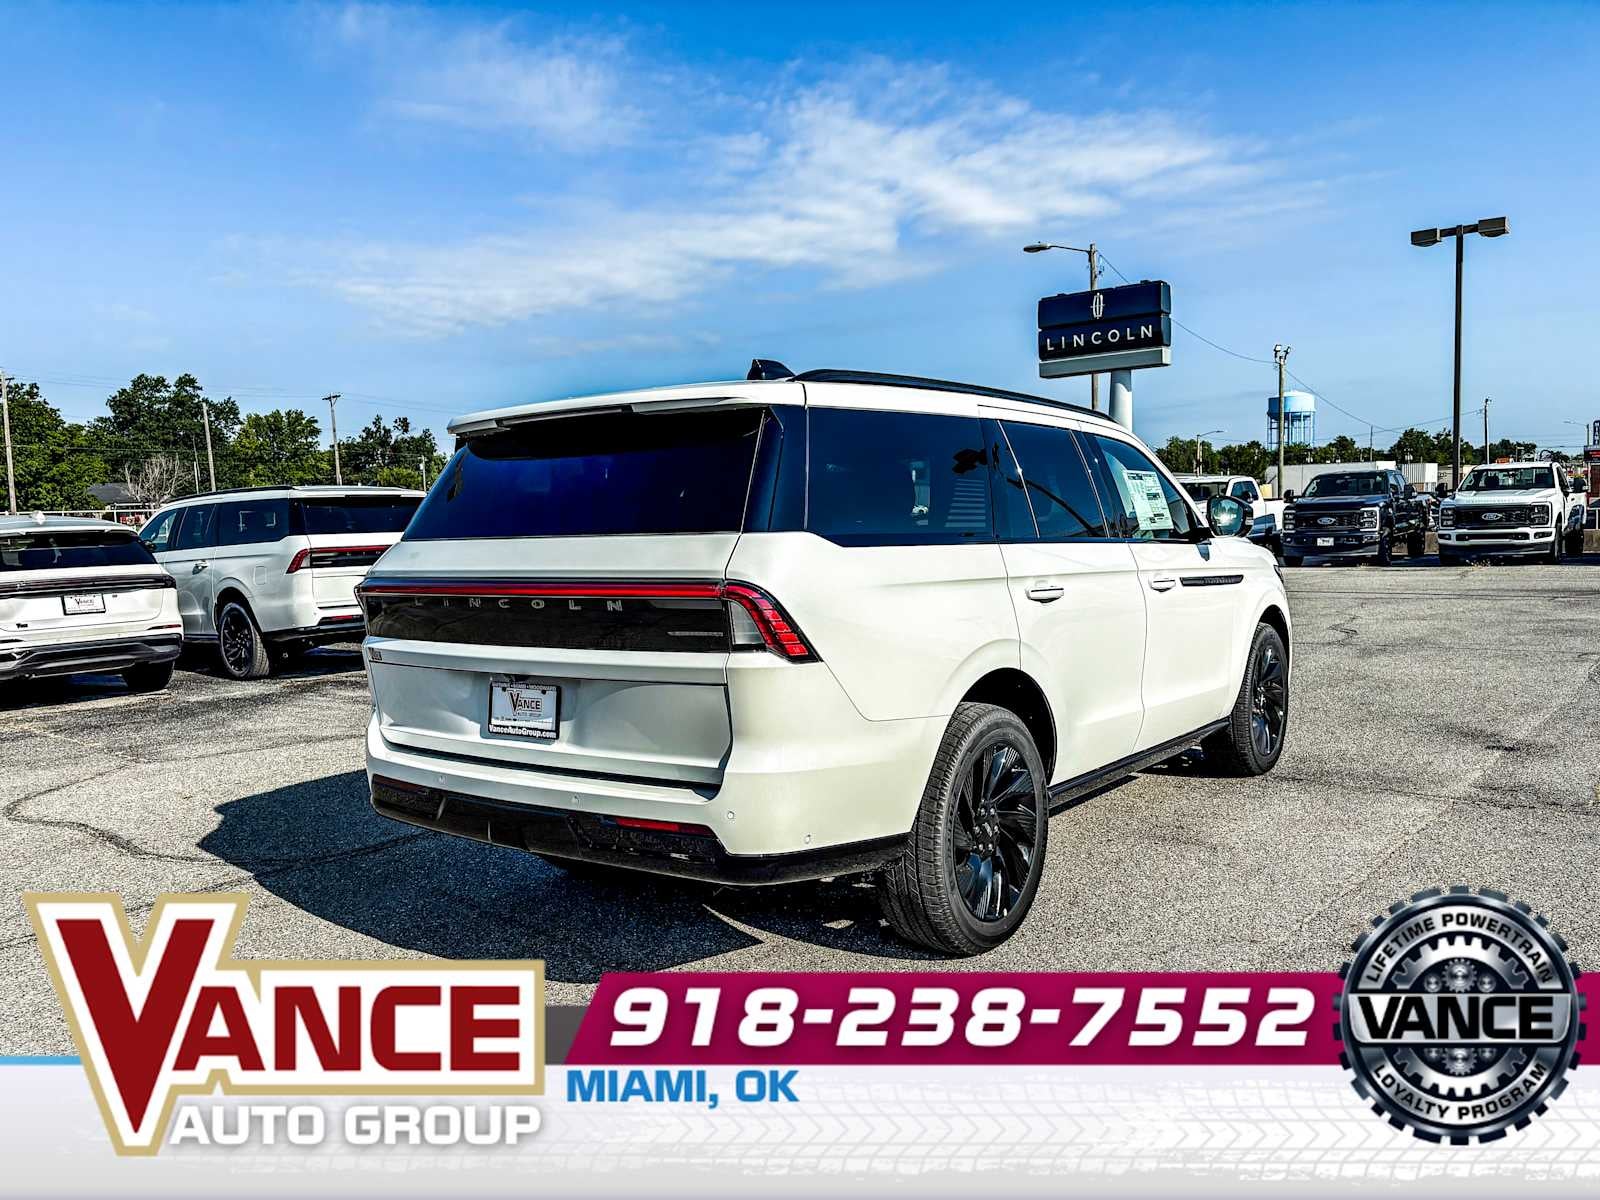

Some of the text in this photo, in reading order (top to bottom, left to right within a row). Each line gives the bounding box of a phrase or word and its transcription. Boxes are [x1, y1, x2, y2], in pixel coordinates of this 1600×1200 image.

[1046, 324, 1153, 352] LINCOLN
[414, 597, 623, 613] LINCOLN
[507, 690, 541, 712] VANCE
[488, 723, 557, 739] VanceAutoGroup.com
